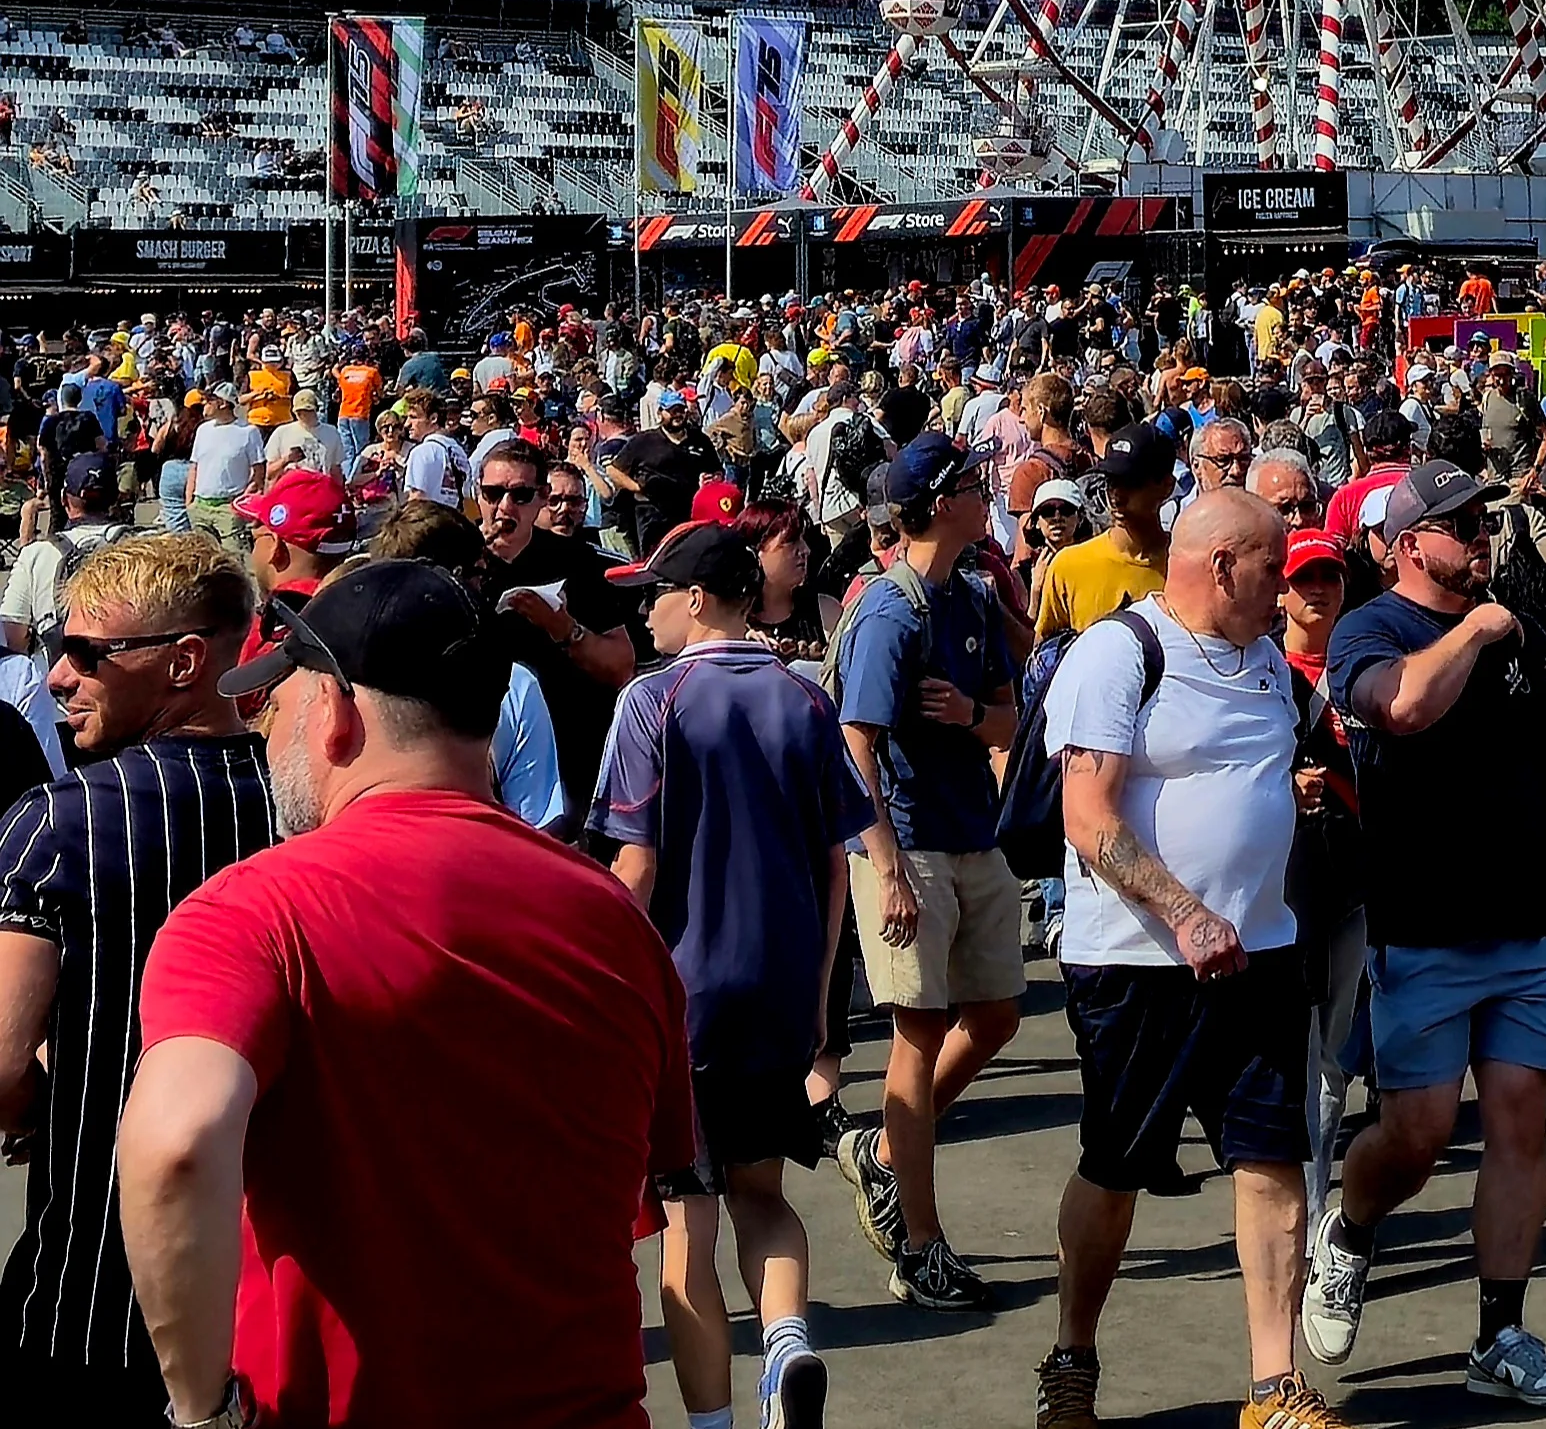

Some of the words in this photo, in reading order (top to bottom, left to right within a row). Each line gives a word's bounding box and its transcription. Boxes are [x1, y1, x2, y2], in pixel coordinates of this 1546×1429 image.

[1238, 188, 1261, 209] ICE
[1265, 187, 1315, 209] CREAM
[905, 213, 945, 229] Store
[697, 224, 736, 239] Store
[136, 240, 178, 259] SMASH
[180, 240, 226, 259] BURGER
[349, 236, 380, 254] PIZZA
